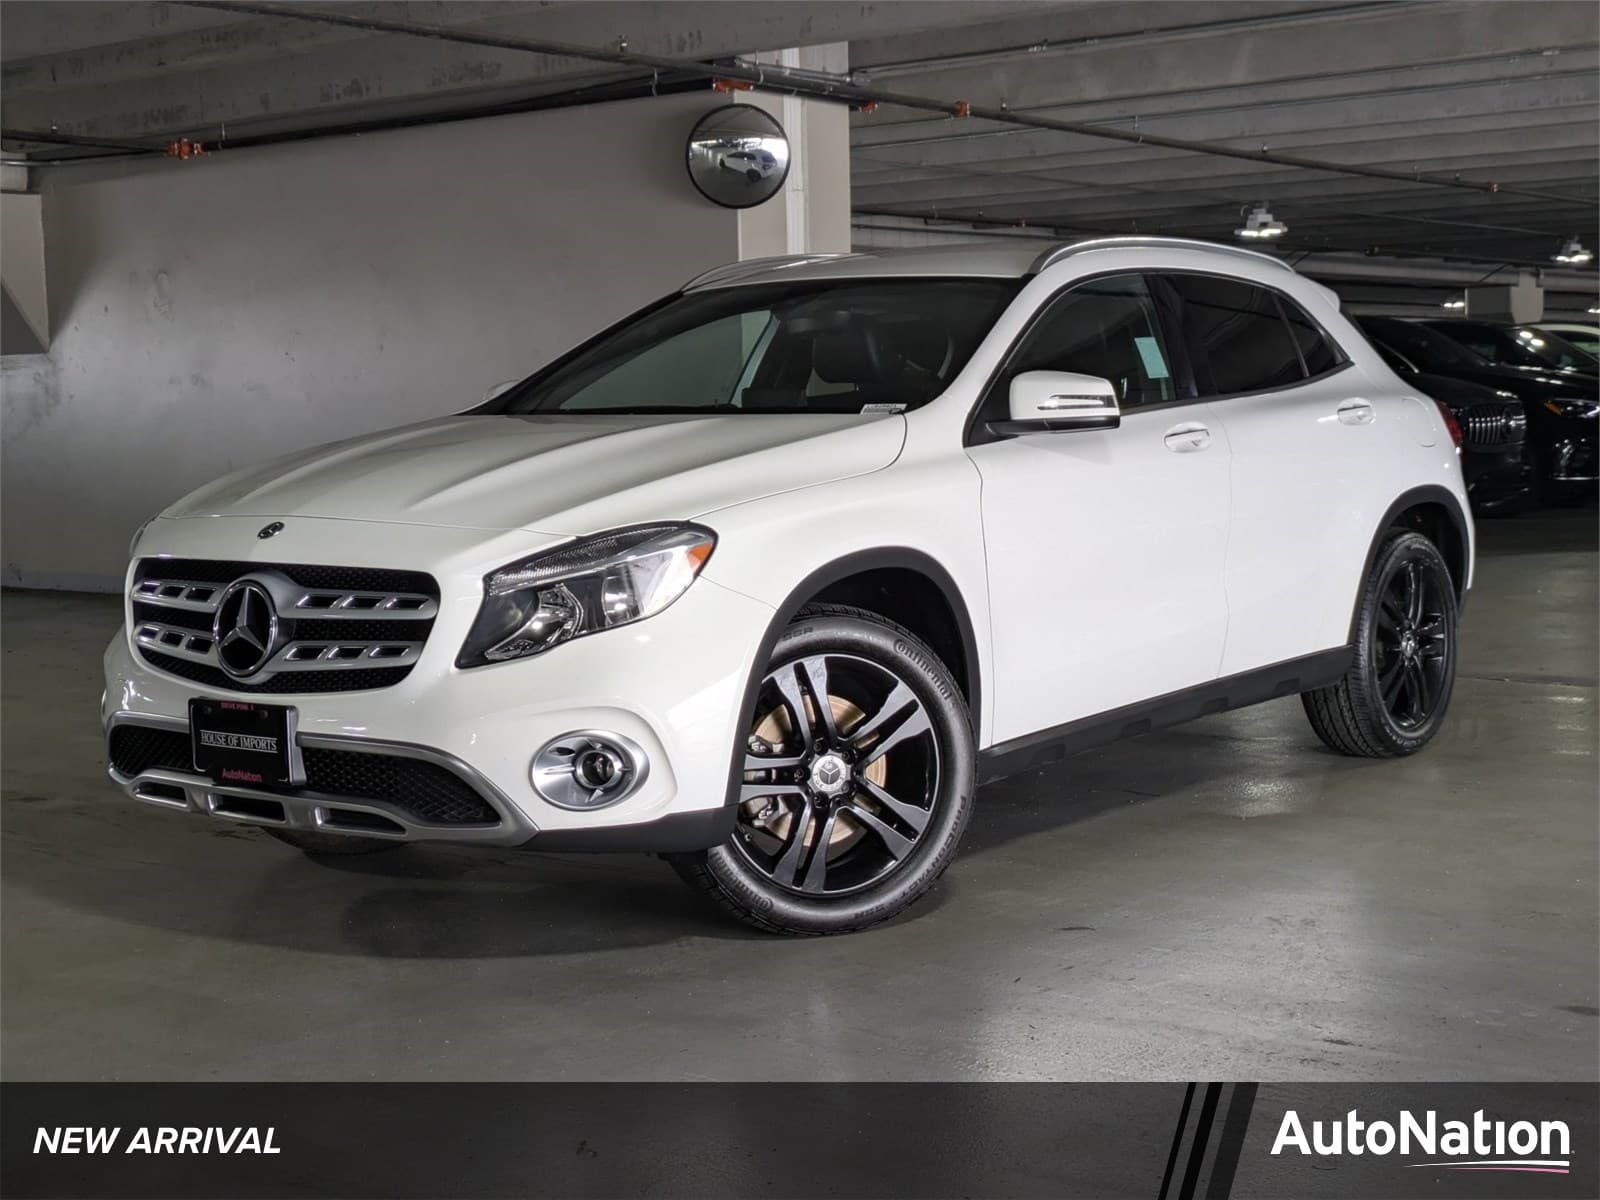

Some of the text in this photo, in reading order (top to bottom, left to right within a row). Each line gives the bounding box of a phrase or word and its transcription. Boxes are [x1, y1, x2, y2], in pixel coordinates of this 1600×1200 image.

[893, 638, 953, 701] Continental
[200, 731, 277, 751] HOUSE OF IMPORTS
[222, 768, 262, 783] AutoNation
